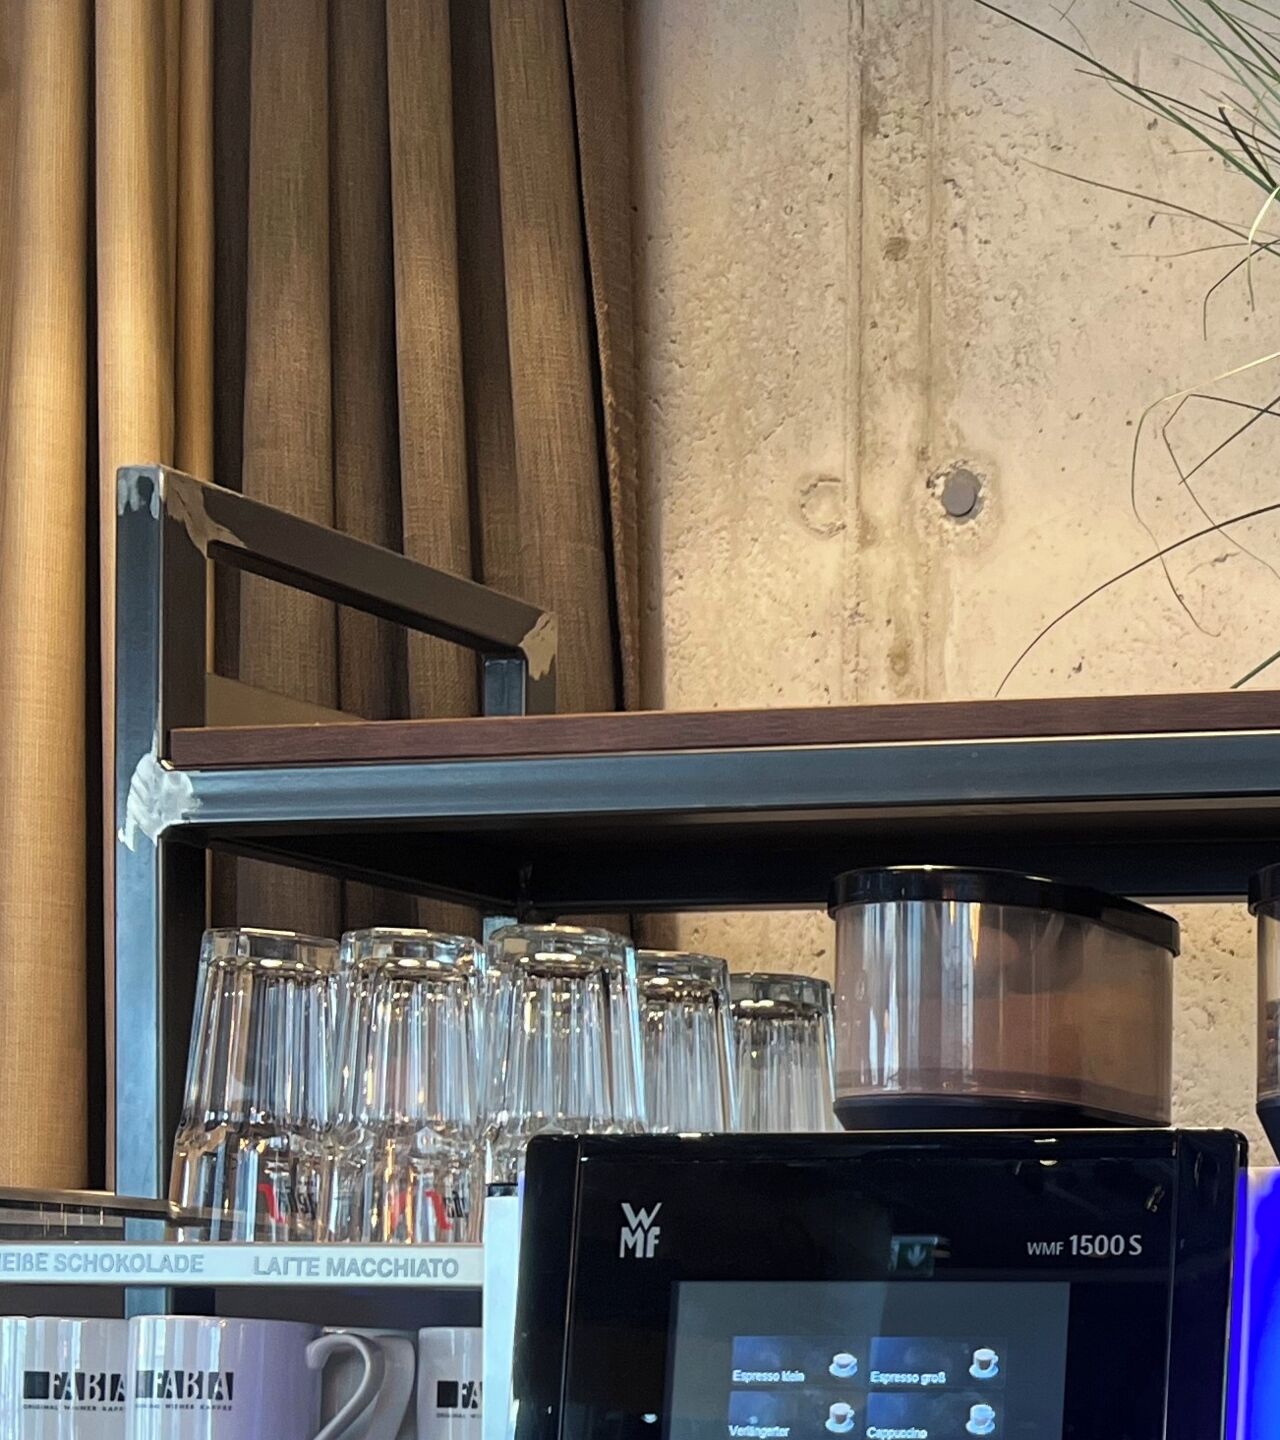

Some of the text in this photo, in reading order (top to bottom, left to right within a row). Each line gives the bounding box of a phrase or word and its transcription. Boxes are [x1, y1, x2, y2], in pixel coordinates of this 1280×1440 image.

[1026, 1234, 1144, 1257] WMF 1500 S
[0, 1252, 205, 1274] EIßE SCHOKOLADE
[325, 1256, 460, 1279] MACCHIATO
[152, 1370, 235, 1401] FABIA
